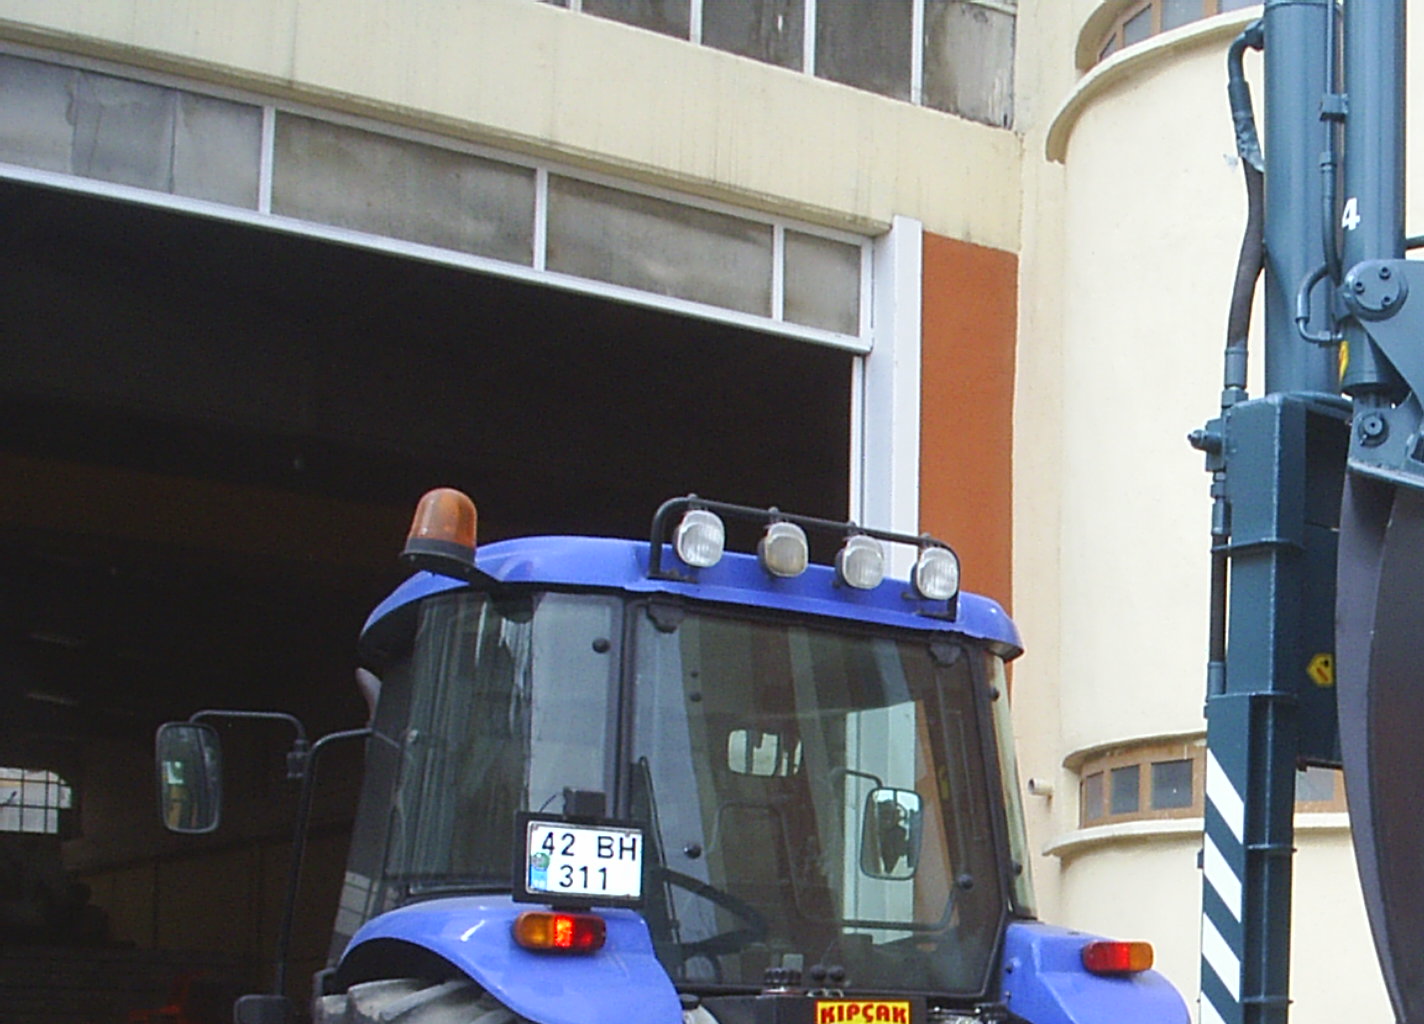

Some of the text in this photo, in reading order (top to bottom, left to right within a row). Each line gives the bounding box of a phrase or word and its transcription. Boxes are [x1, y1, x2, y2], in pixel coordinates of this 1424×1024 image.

[1342, 197, 1360, 230] 4
[542, 832, 636, 861] 42 BH
[559, 864, 608, 890] 311
